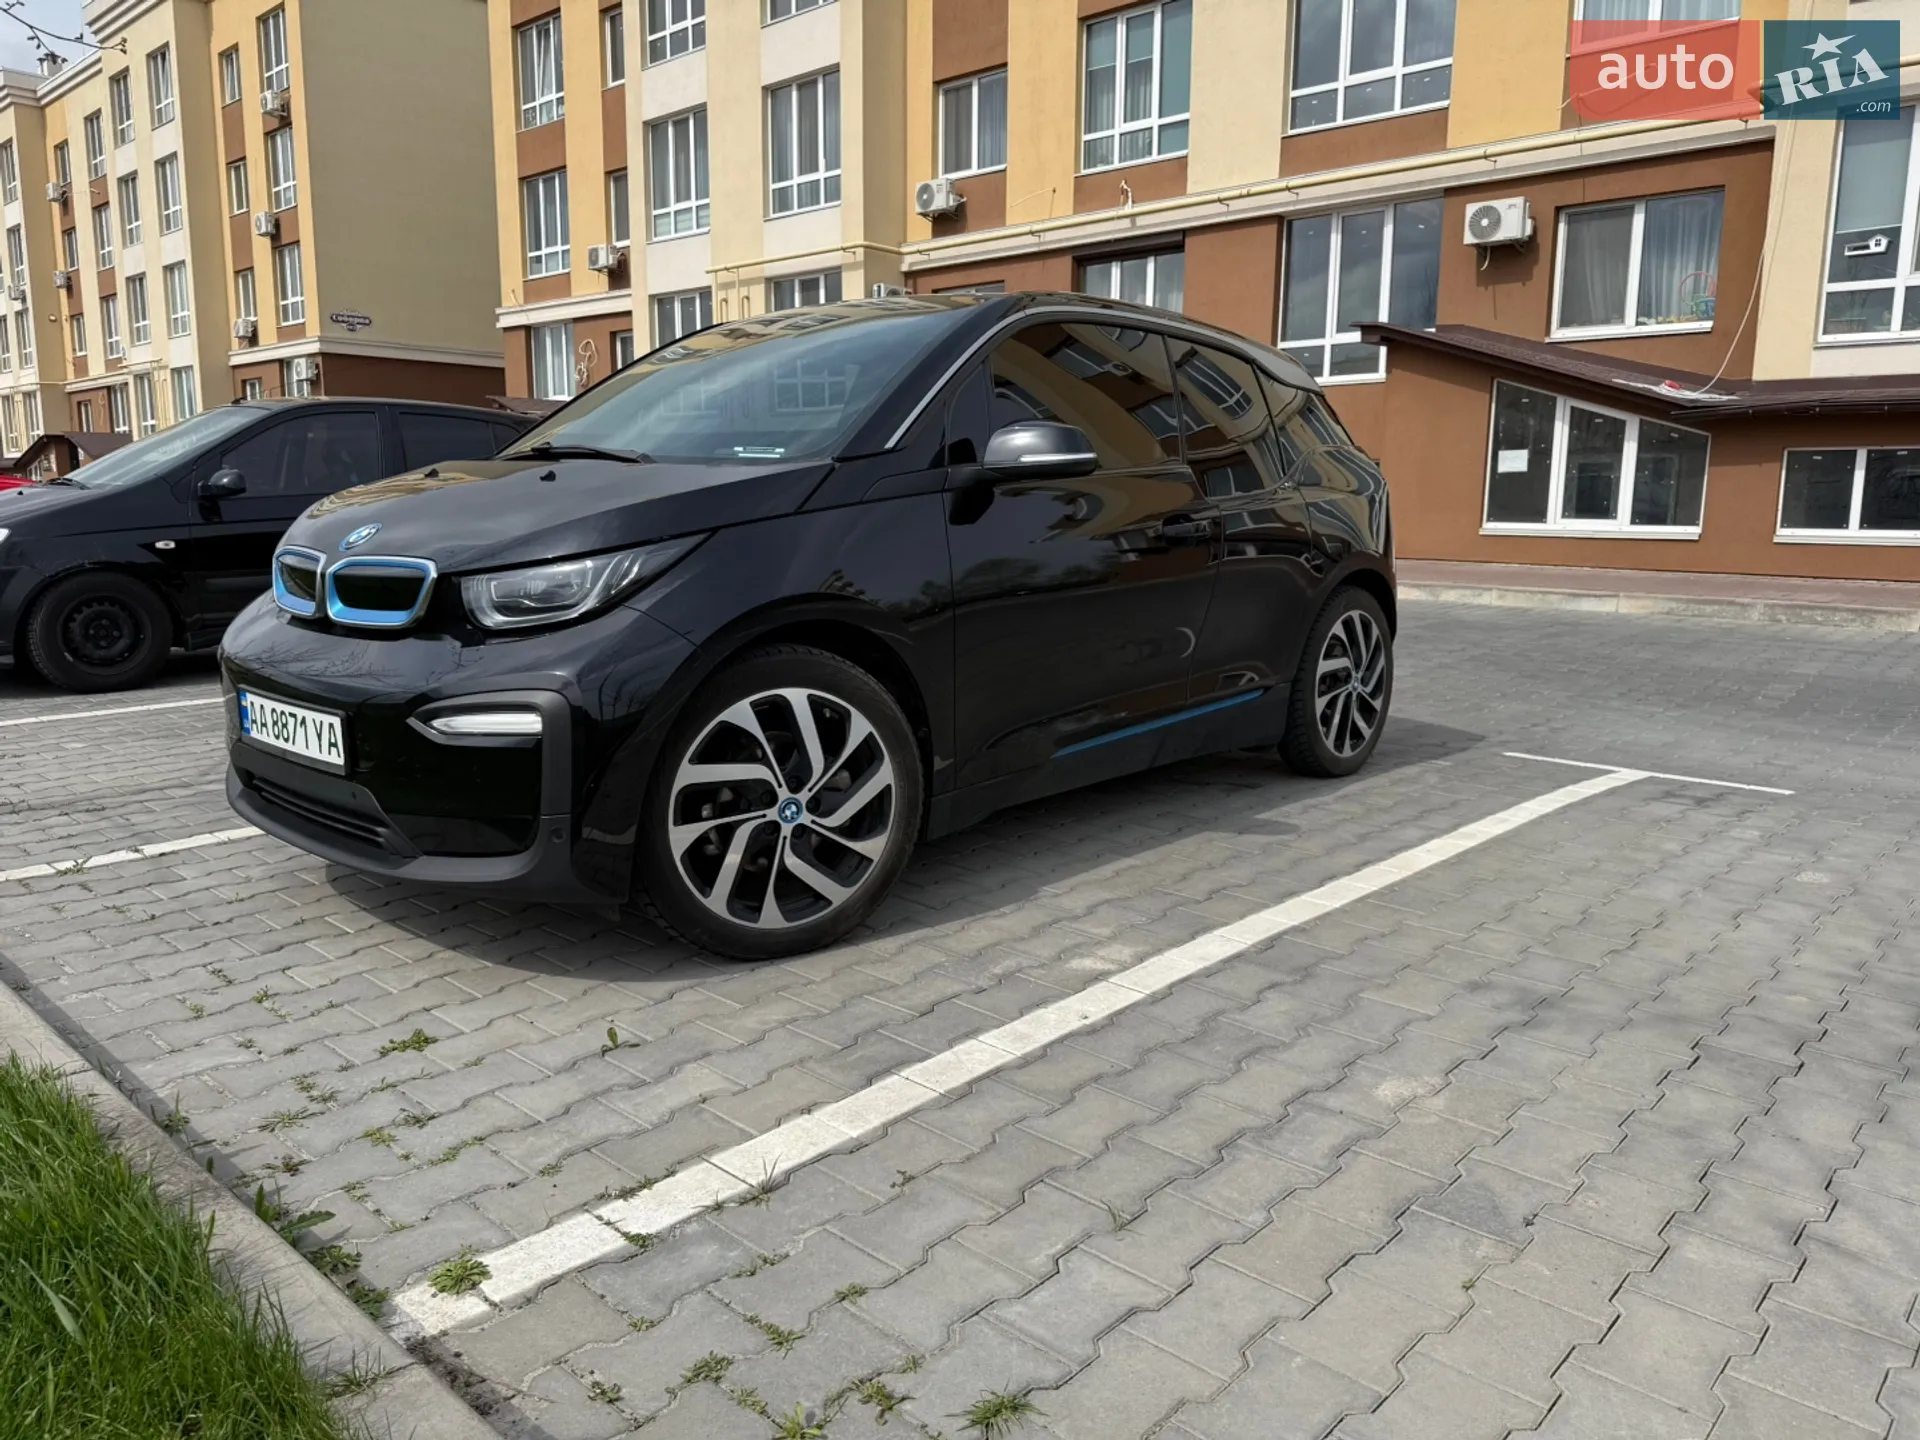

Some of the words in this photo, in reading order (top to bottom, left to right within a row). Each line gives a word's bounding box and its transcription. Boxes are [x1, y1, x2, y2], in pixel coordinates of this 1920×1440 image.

[250, 700, 270, 738] AA
[270, 707, 310, 751] 8871
[312, 717, 342, 759] YA
